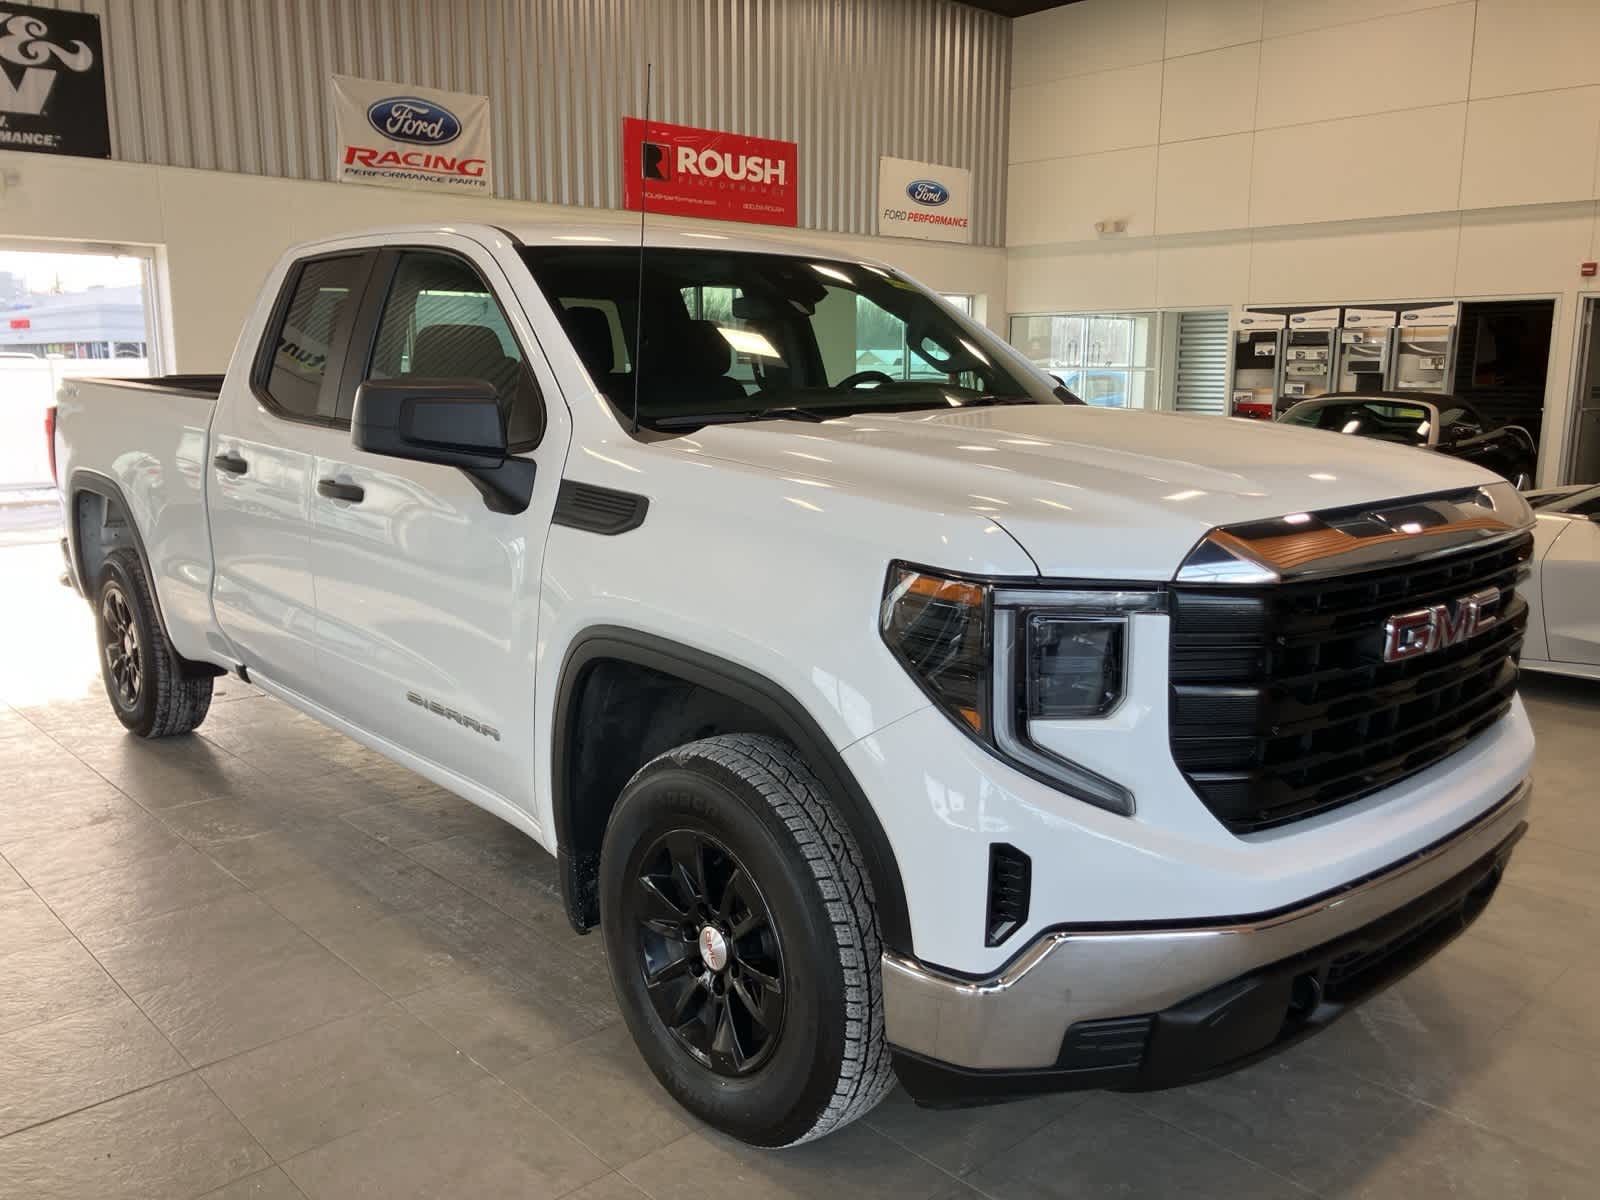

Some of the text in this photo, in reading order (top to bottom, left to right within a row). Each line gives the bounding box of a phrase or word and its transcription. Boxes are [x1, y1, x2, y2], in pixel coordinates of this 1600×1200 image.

[386, 103, 444, 139] Ford
[344, 145, 486, 177] RACING
[344, 167, 486, 187] PERFORMANCE PARTS
[677, 145, 785, 186] ROUSH
[914, 183, 941, 202] Ford
[883, 209, 968, 228] FORD PERFORMANCE
[1384, 586, 1500, 662] GMC
[406, 690, 500, 742] SIERRA
